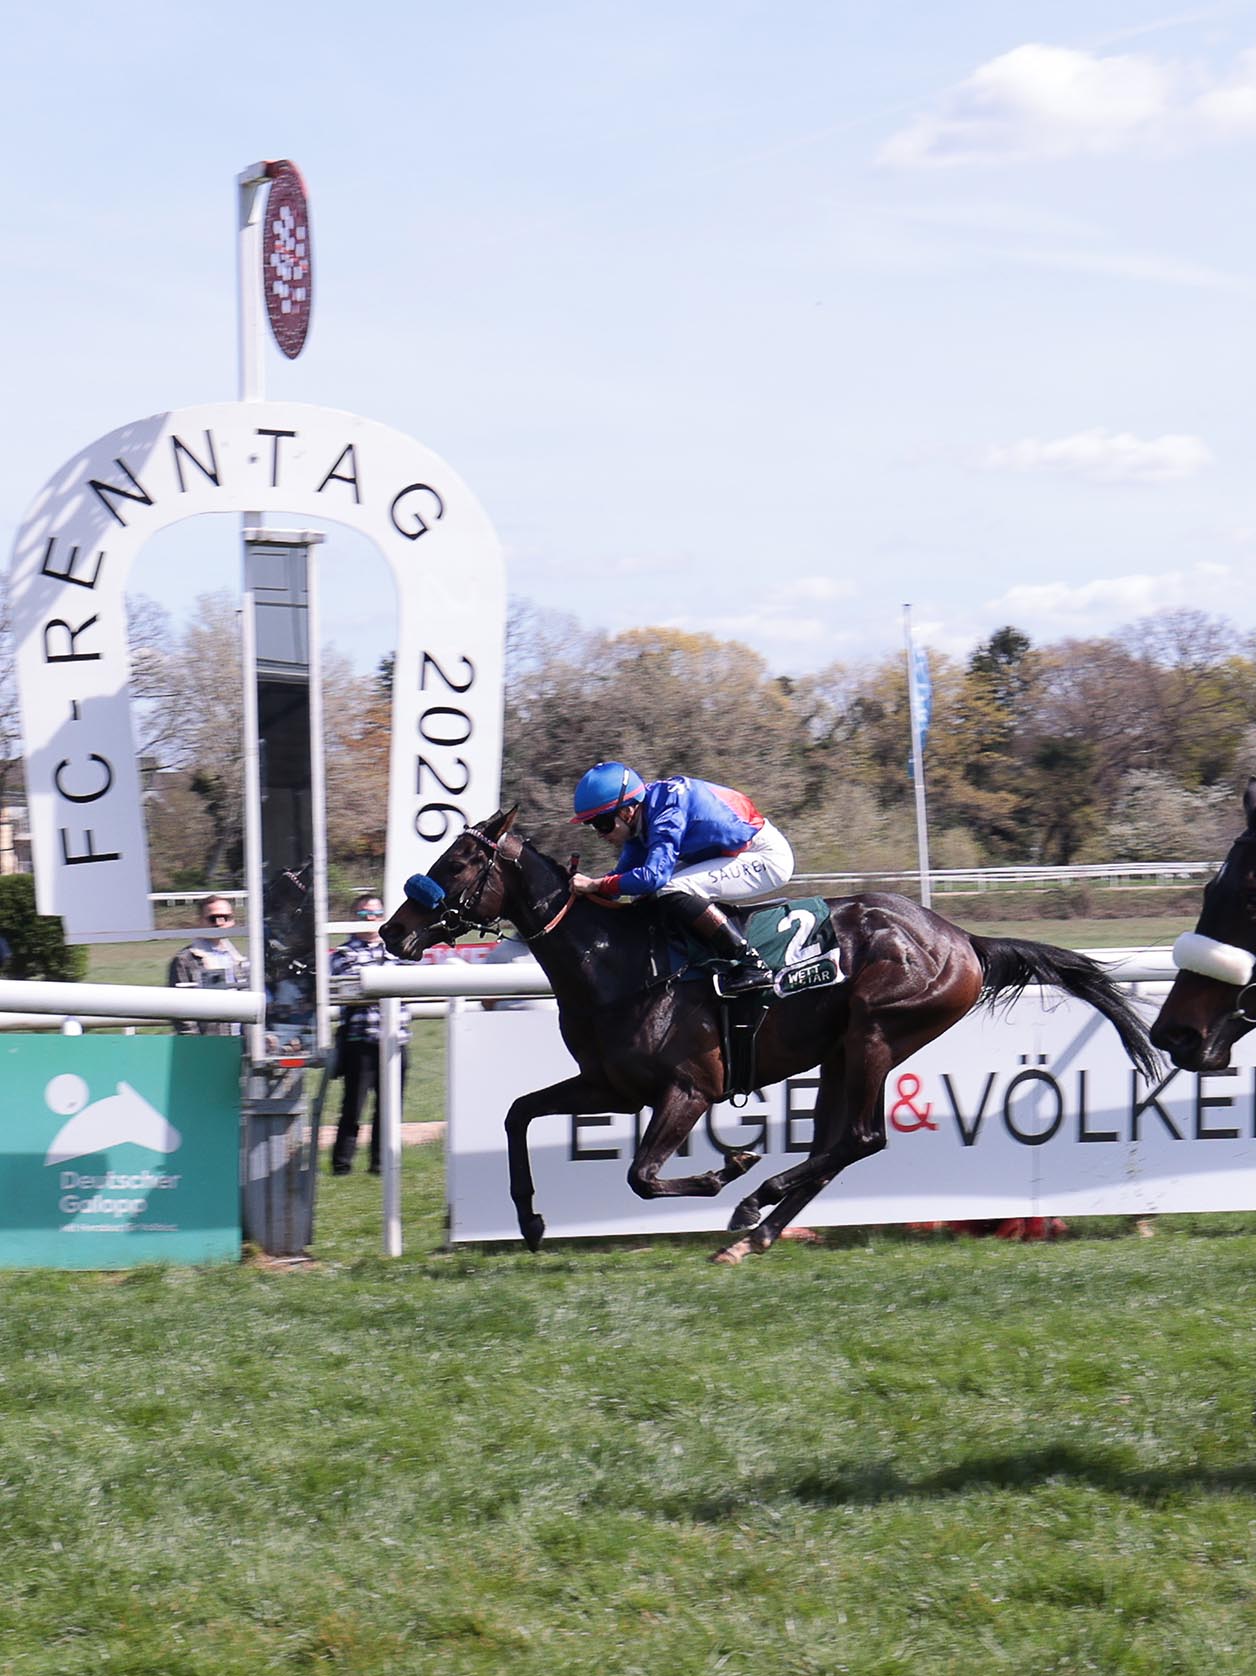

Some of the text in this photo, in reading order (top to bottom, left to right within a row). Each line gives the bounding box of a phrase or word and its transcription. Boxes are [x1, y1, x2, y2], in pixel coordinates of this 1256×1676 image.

[41, 428, 476, 866] FC-RENNTAG 2026
[777, 908, 822, 967] 2
[59, 1170, 182, 1190] Deutscher
[59, 1194, 149, 1218] Galopp
